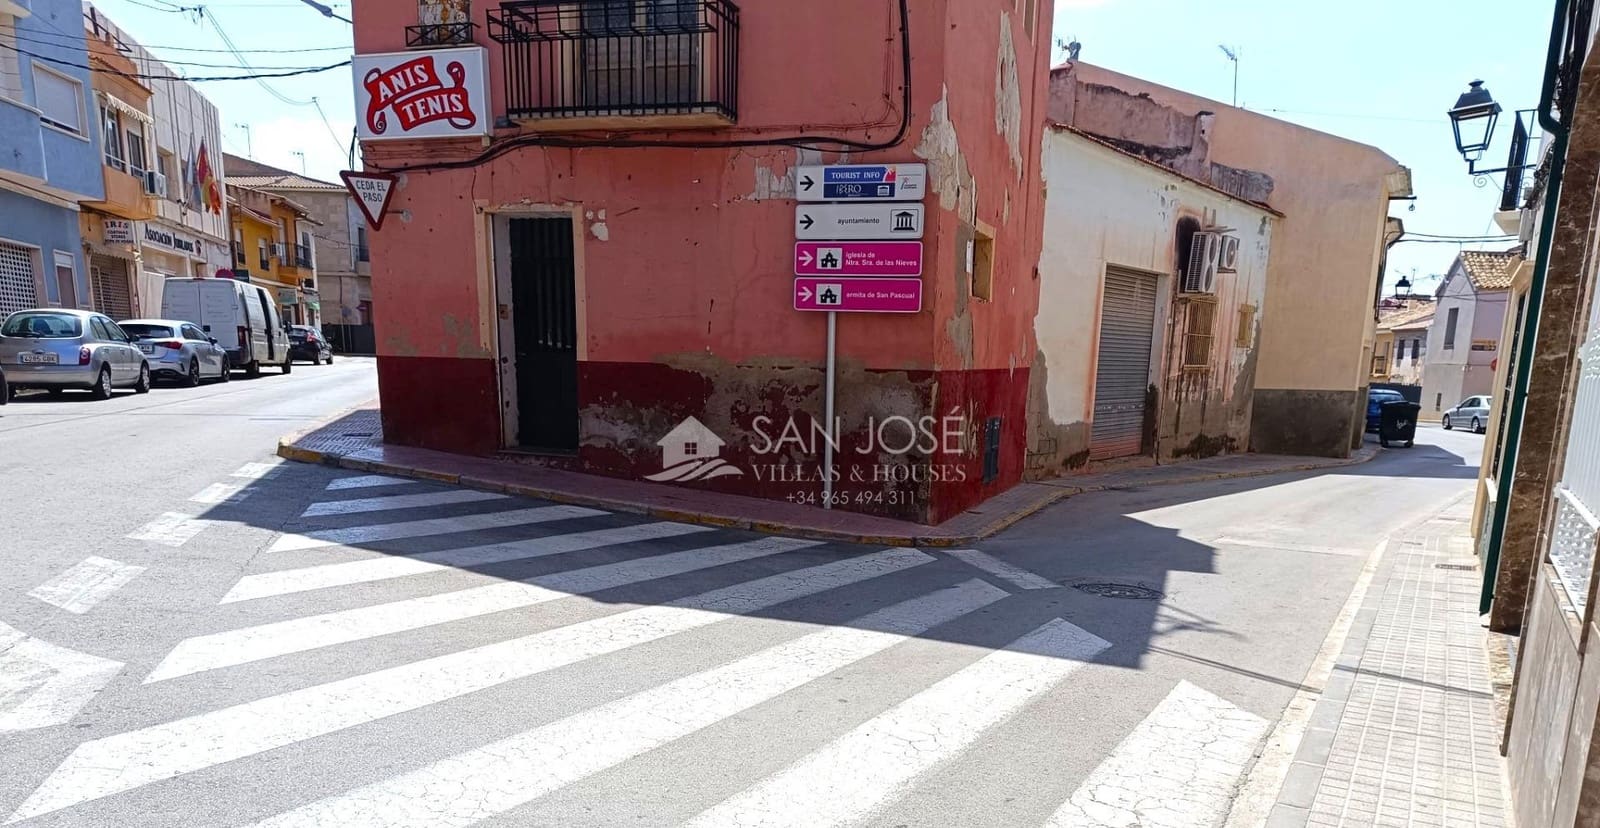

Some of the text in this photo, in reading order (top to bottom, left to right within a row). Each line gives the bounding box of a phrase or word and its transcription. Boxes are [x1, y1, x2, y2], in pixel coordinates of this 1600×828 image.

[378, 64, 430, 102] ANIS
[402, 93, 464, 124] TENIS
[831, 171, 880, 179] TOURIST INFO
[356, 180, 386, 191] CEDA EL
[363, 192, 383, 202] PASO
[104, 221, 129, 229] IRIS
[837, 217, 880, 225] ayuntamiento
